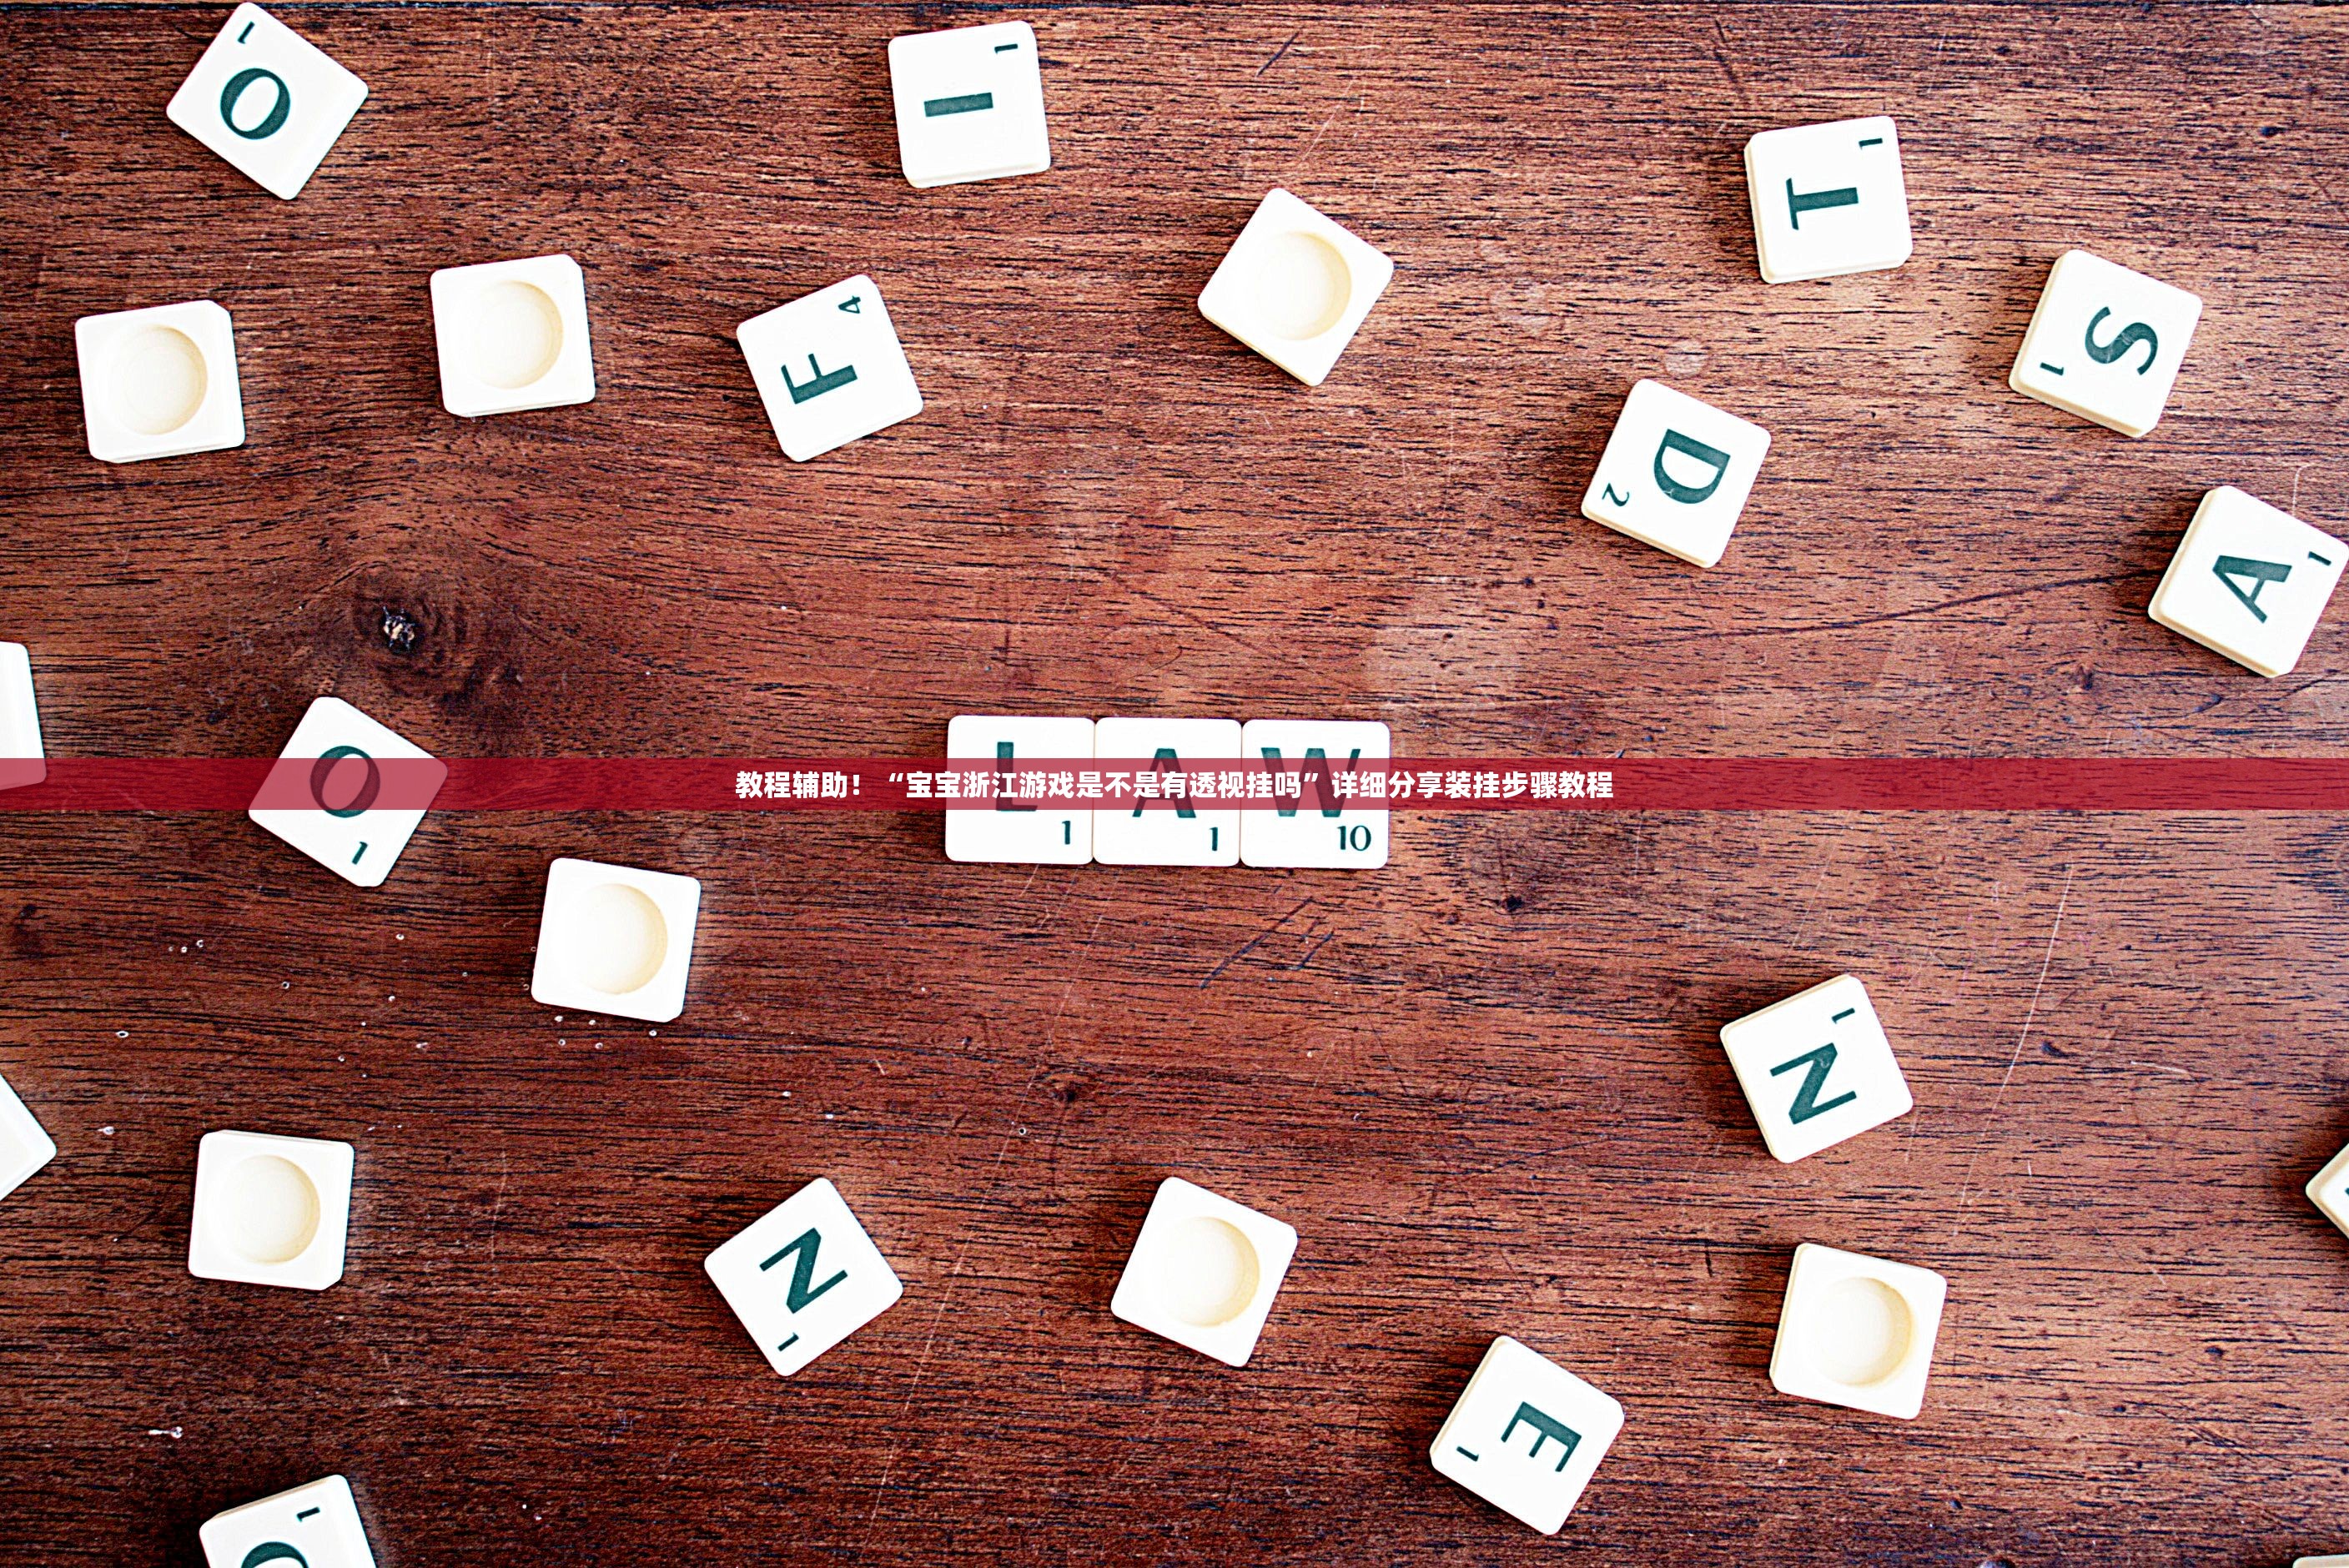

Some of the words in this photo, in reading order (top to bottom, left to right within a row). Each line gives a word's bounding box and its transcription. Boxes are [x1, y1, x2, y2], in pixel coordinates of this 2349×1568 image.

[236, 20, 256, 45] 1
[993, 43, 1019, 55] 1
[219, 66, 292, 141] O
[923, 91, 995, 118] I
[1857, 137, 1884, 149] 1
[1784, 177, 1860, 232] T
[837, 294, 863, 315] 4
[2084, 305, 2160, 376] S
[780, 352, 859, 405] F
[2039, 361, 2065, 377] 1
[1652, 427, 1732, 505] D
[1601, 482, 1631, 508] 2
[2306, 550, 2332, 567] 1
[2211, 554, 2293, 625] A
[309, 744, 382, 819] O
[1060, 819, 1073, 846] 1
[1208, 826, 1220, 852] 1
[1335, 824, 1373, 852] 10
[350, 840, 369, 866] 1
[1830, 1007, 1857, 1025] 1
[1768, 1041, 1858, 1126] N
[758, 1226, 849, 1315] N
[777, 1332, 800, 1353] 1
[1500, 1400, 1583, 1474] E
[1455, 1445, 1480, 1463] 1
[295, 1505, 322, 1523] 1
